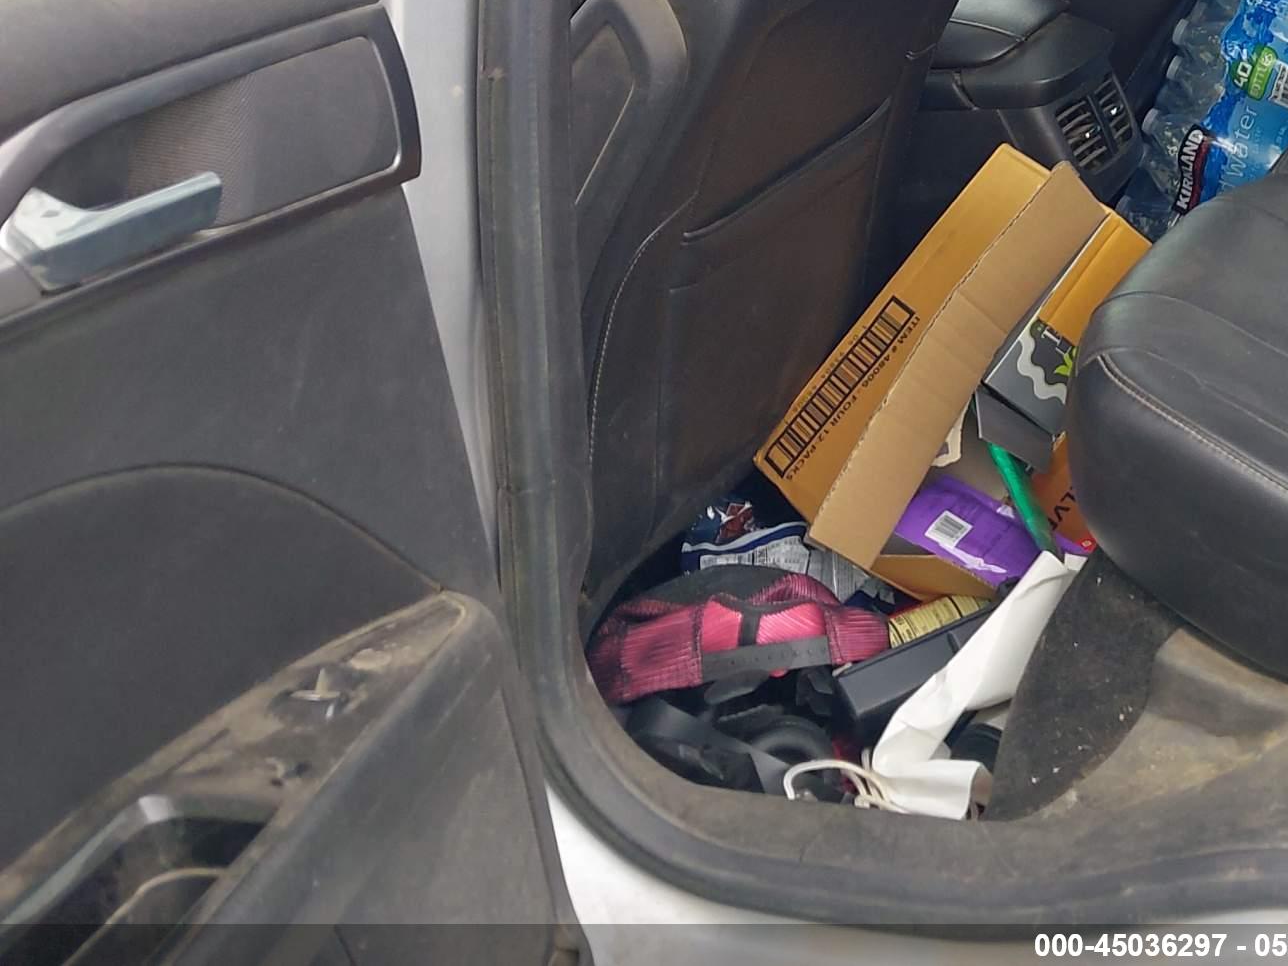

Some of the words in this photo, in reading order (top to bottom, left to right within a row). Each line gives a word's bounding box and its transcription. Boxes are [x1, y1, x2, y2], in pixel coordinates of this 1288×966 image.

[1233, 60, 1252, 88] 40
[897, 316, 921, 344] ITEM
[828, 394, 857, 427] FOUR
